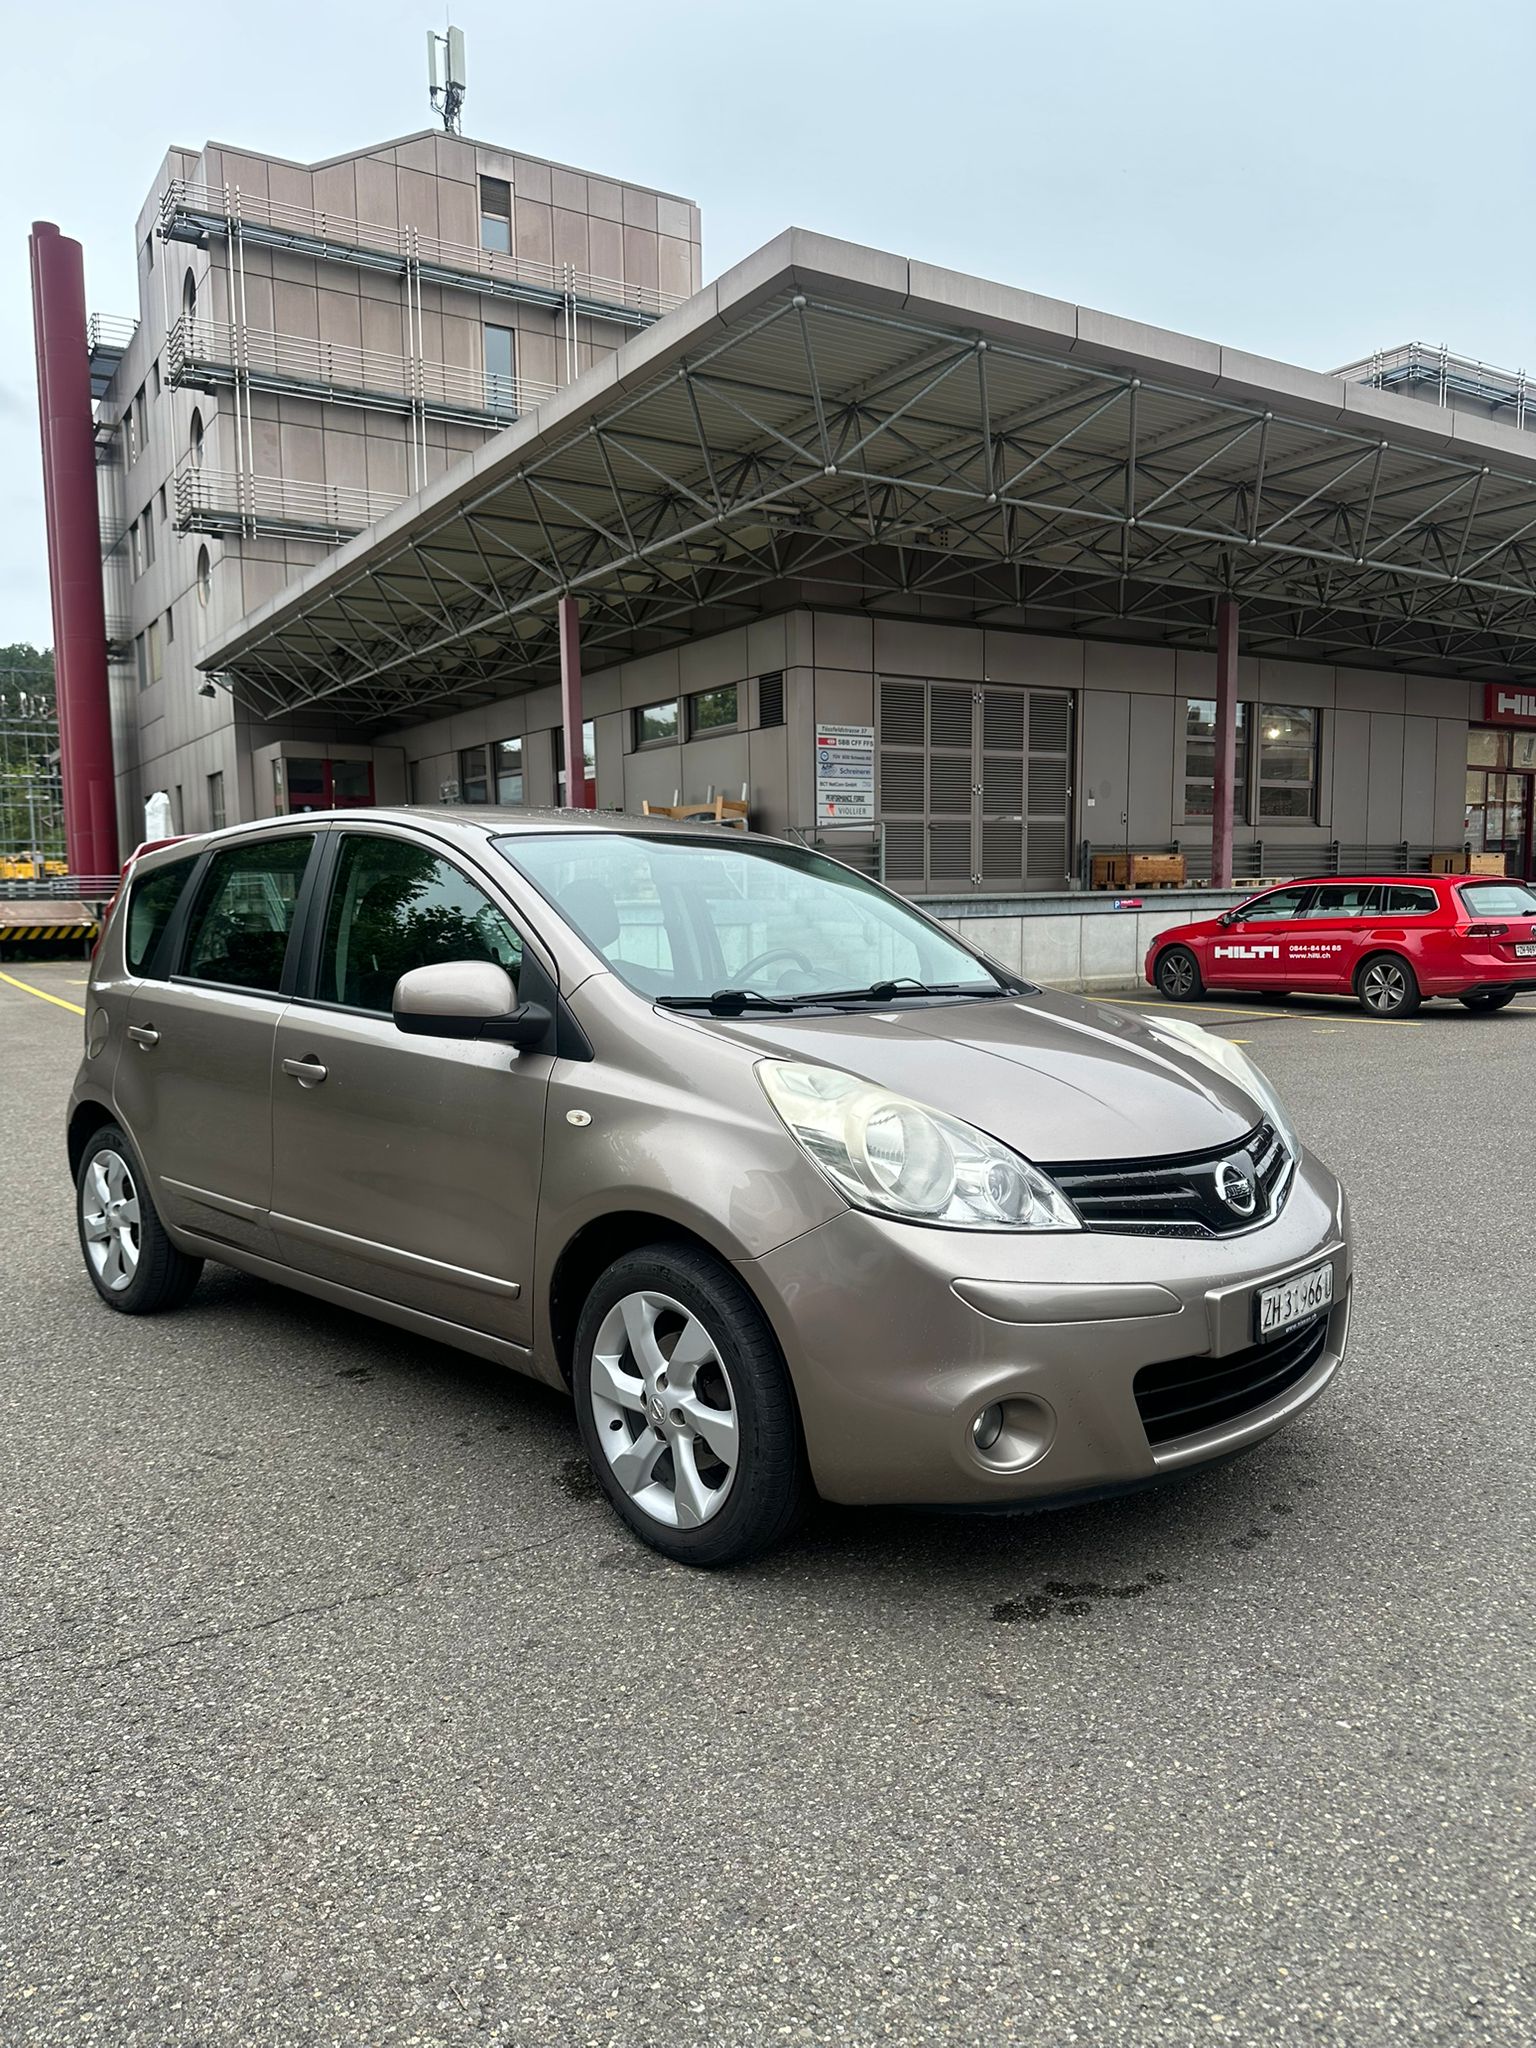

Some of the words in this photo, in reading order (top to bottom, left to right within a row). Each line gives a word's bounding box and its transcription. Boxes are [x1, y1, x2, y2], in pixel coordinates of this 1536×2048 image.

[837, 807, 867, 815] VIOLLIER
[1214, 945, 1280, 959] HILTI
[1264, 1294, 1281, 1327] ZH
